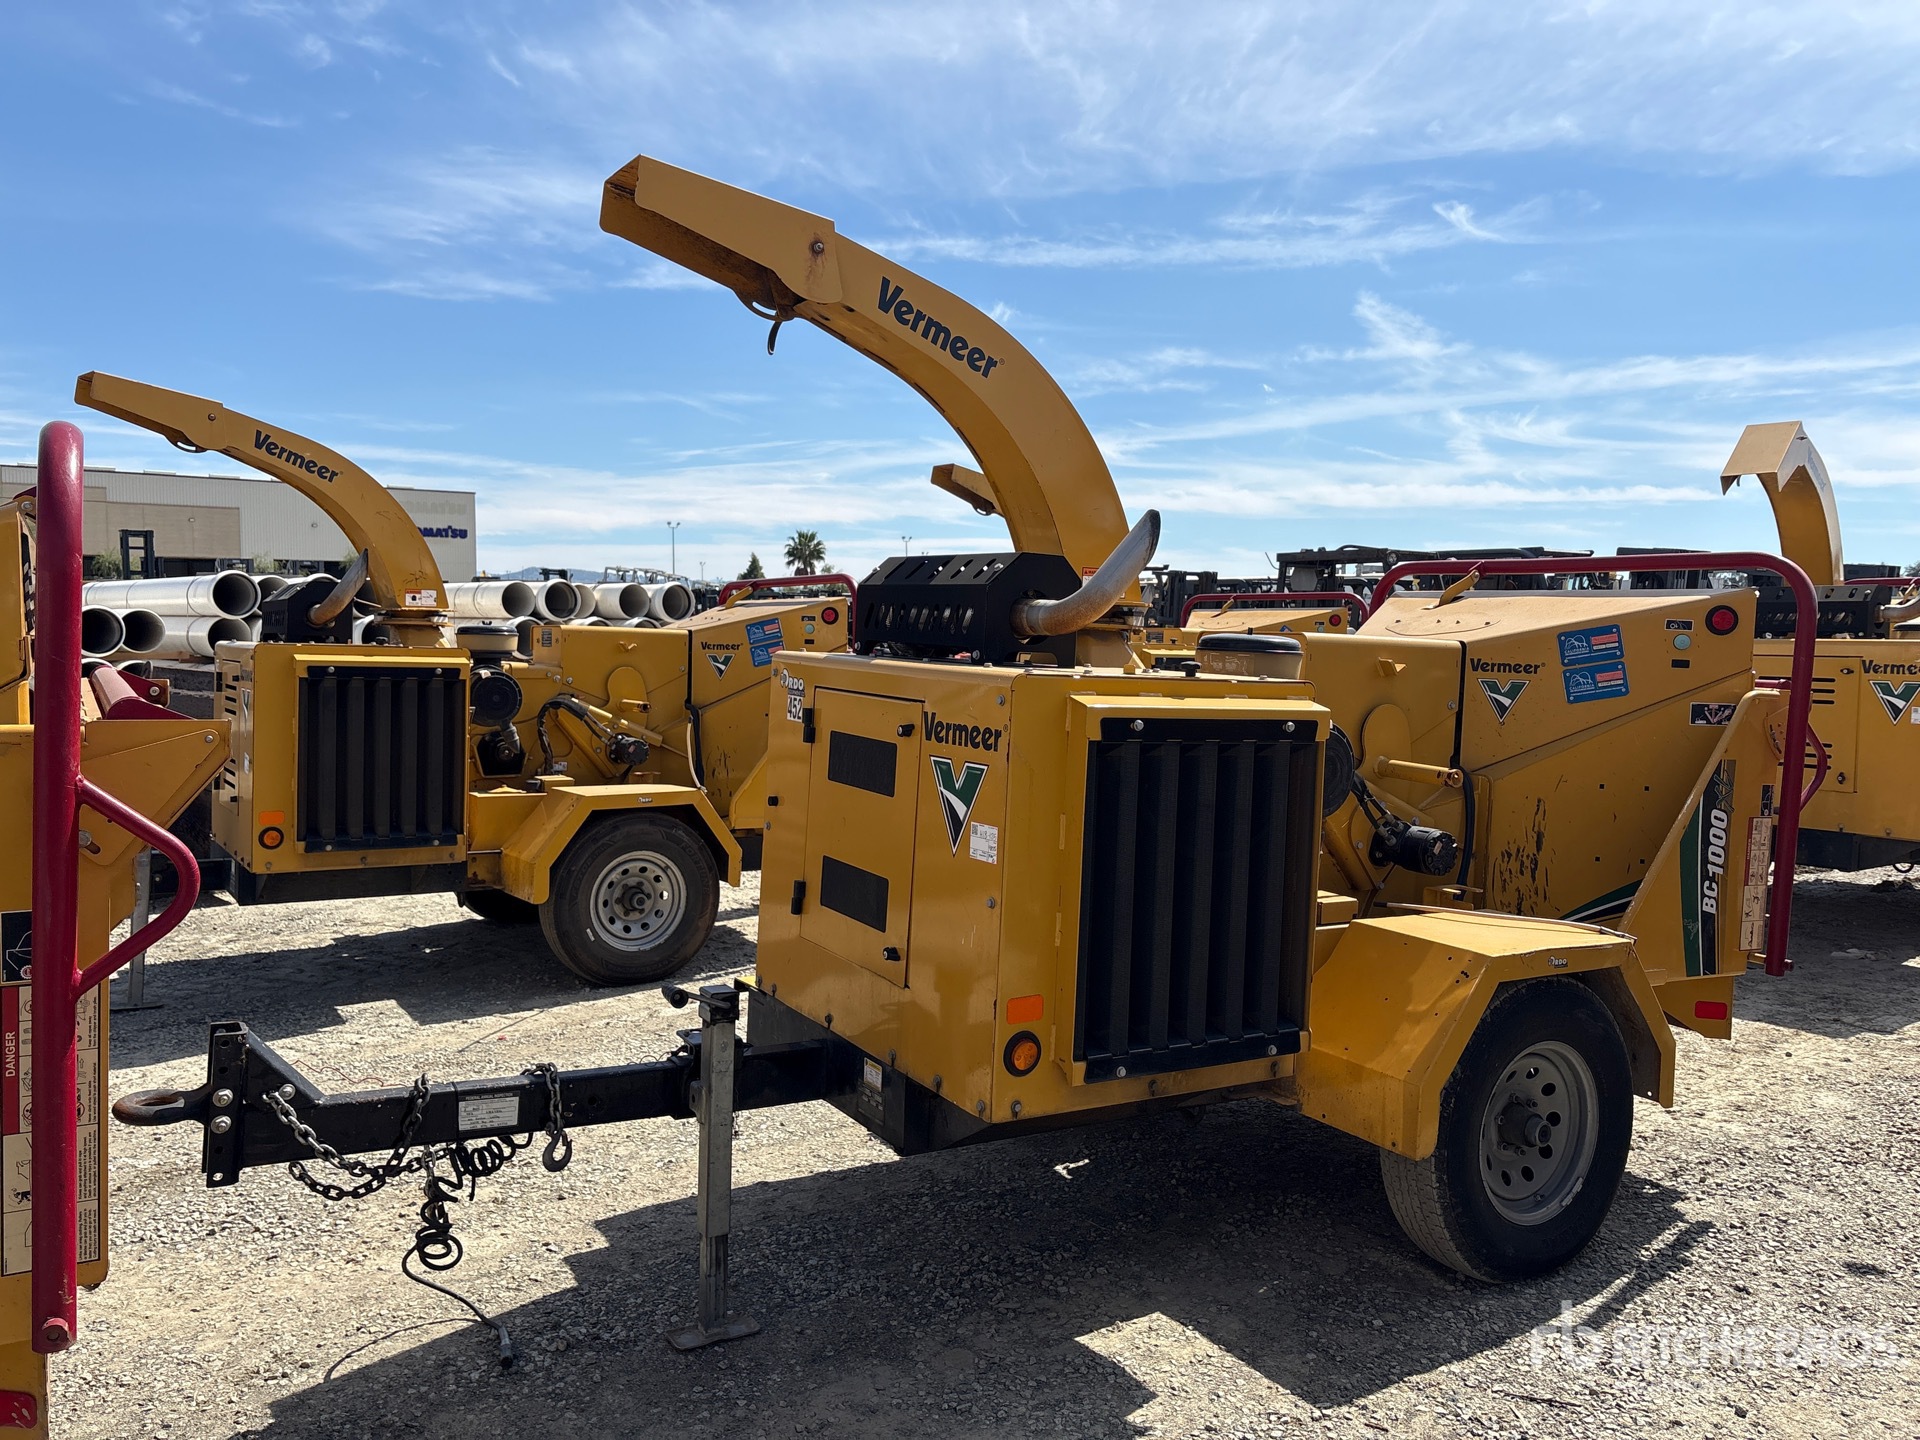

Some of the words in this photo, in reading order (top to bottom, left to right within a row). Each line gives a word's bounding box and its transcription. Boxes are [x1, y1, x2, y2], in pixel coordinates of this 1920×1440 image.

[787, 697, 802, 720] 452
[1707, 808, 1728, 877] 1000
[5, 1031, 17, 1078] DANGER
